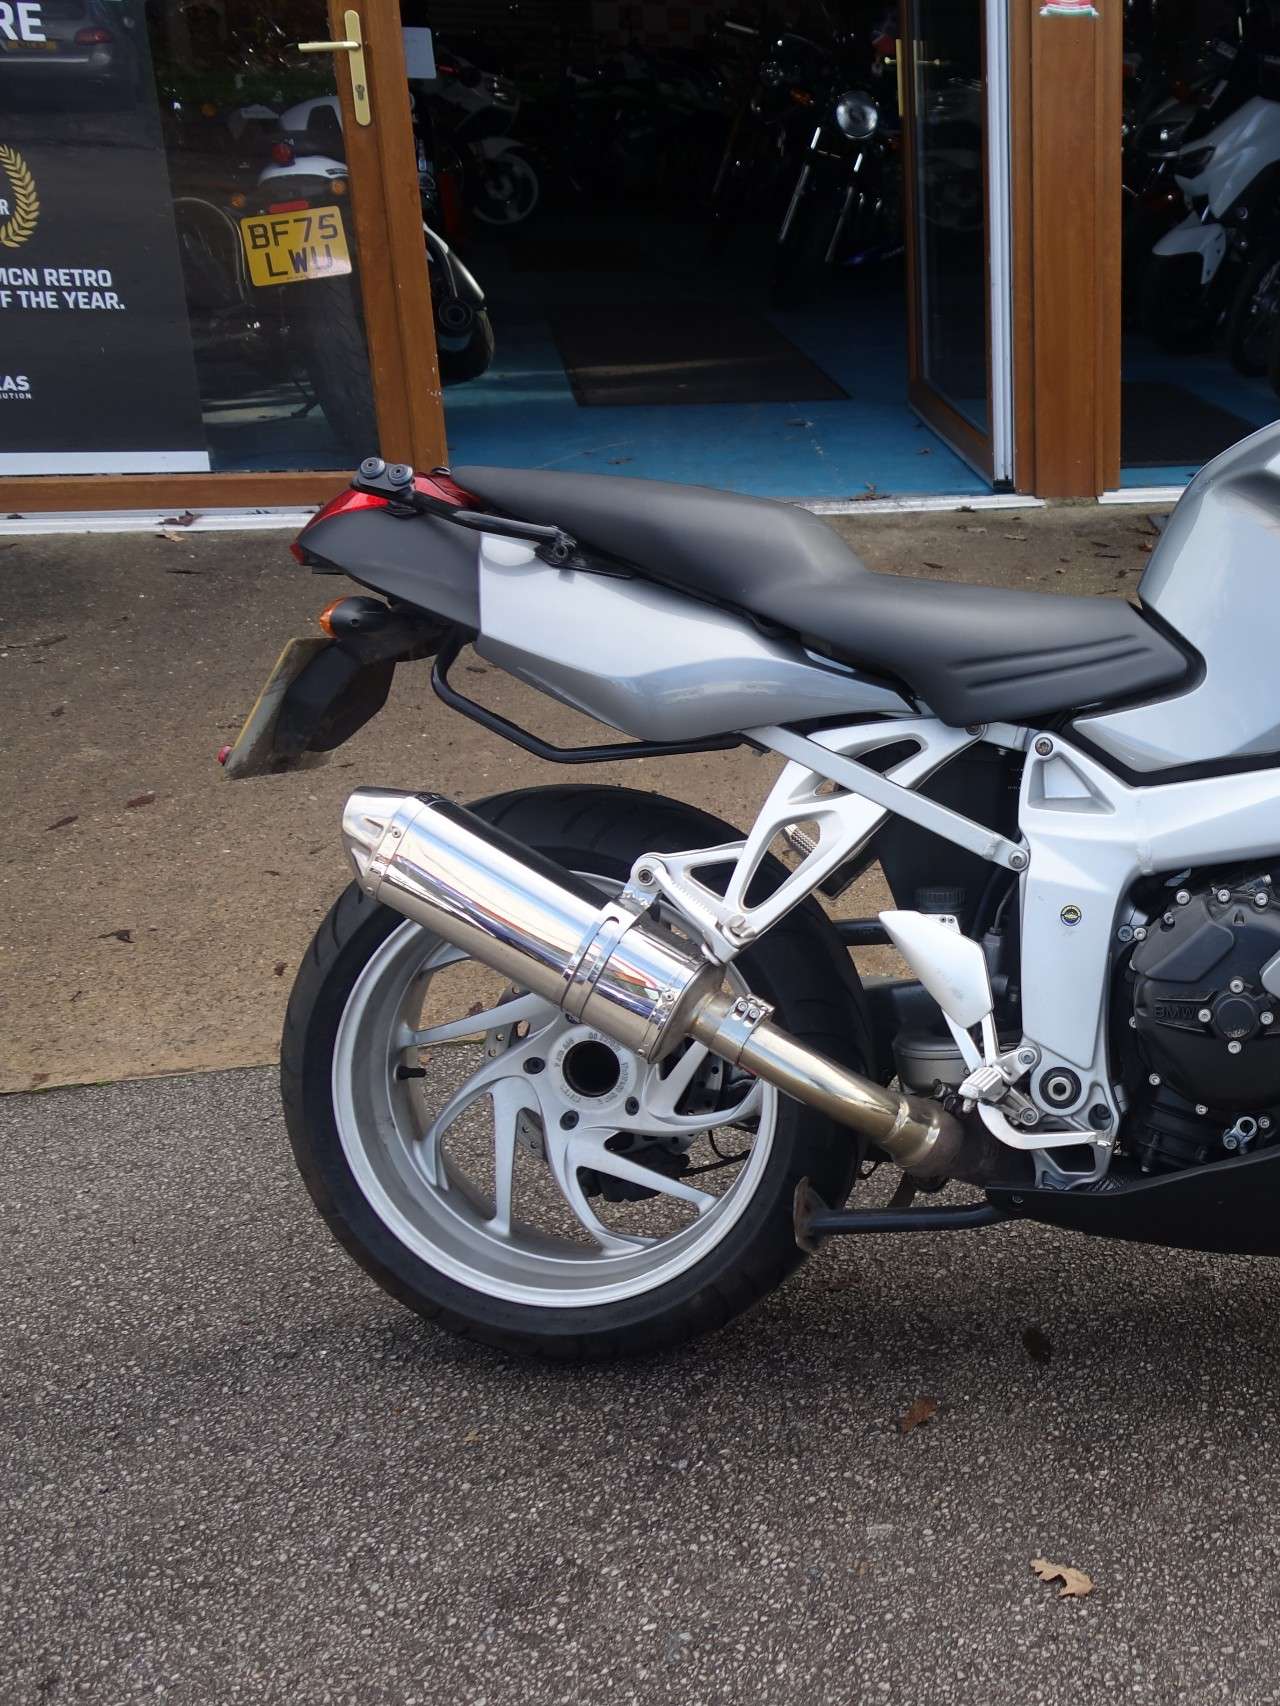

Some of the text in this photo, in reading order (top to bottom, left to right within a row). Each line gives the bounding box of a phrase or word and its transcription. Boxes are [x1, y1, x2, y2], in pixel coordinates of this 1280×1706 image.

[248, 214, 337, 249] BF75
[265, 244, 333, 277] LWU
[43, 268, 112, 287] RETRO
[16, 290, 59, 309] THE
[62, 291, 126, 310] YEAR.
[0, 392, 32, 400] UTION
[1154, 1005, 1198, 1018] BMW
